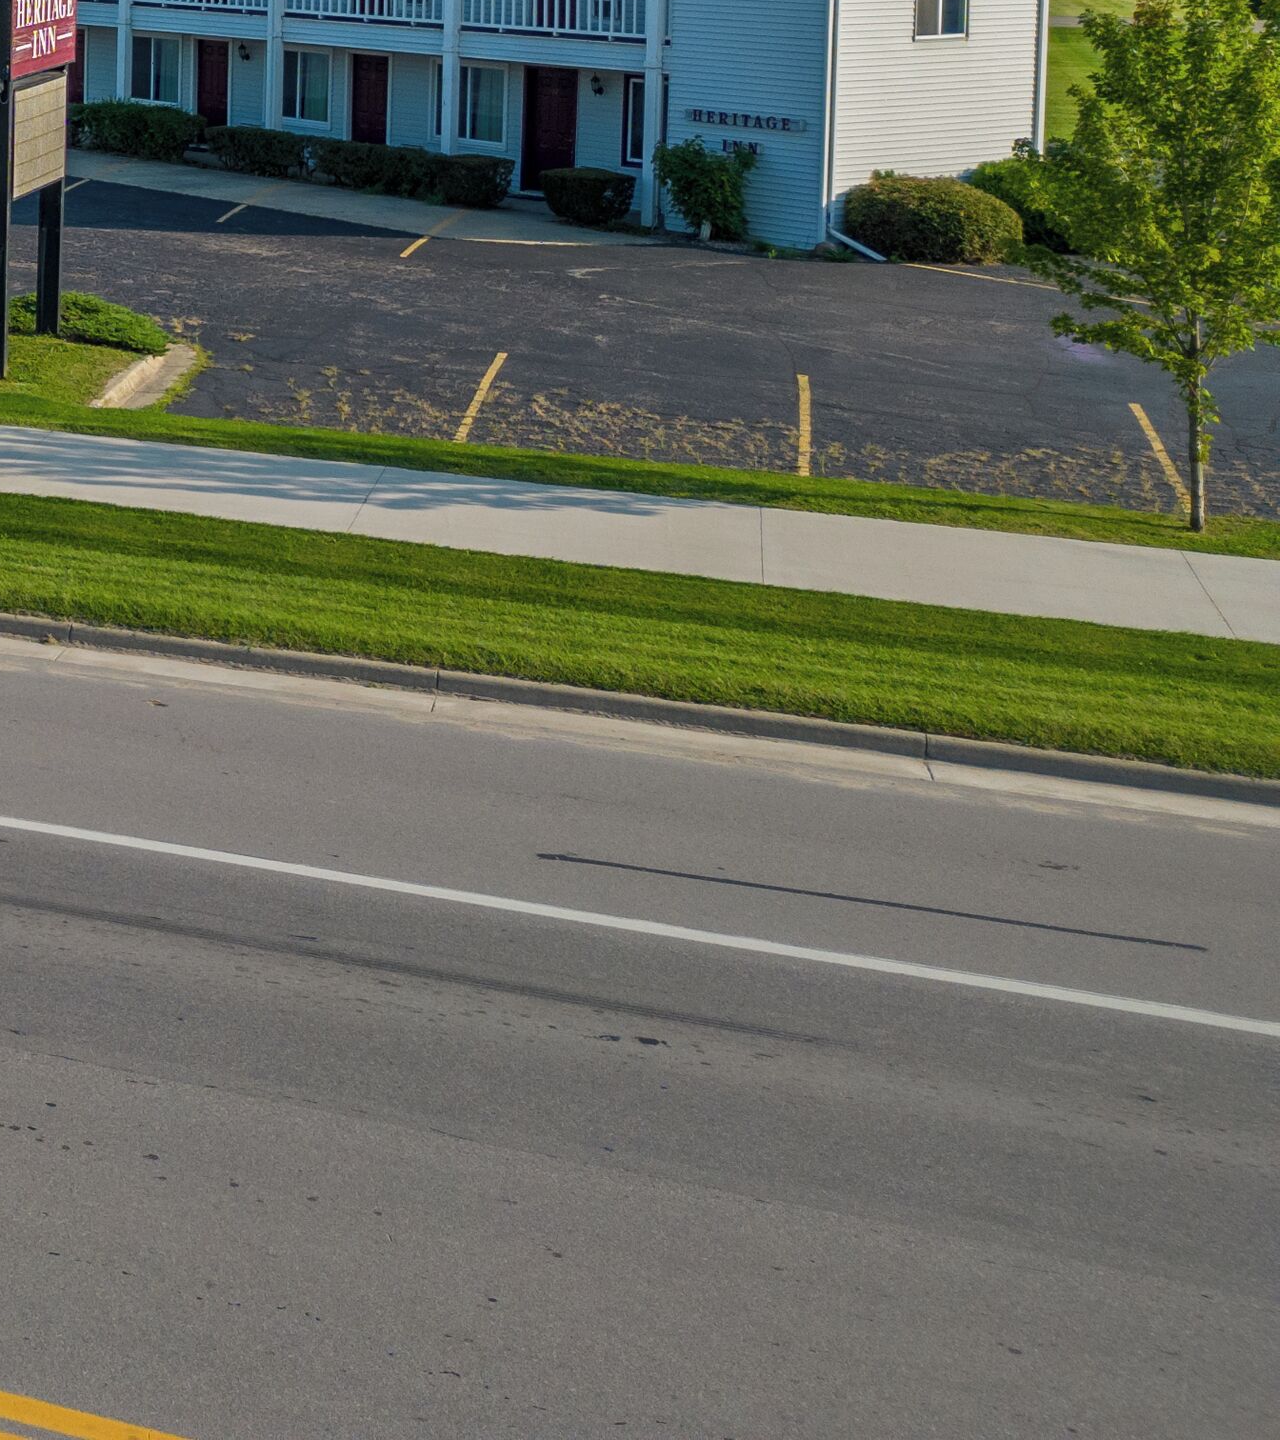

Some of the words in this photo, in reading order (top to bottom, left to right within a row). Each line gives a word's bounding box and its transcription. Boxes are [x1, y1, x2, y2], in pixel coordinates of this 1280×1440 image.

[32, 25, 57, 58] INN
[692, 109, 791, 131] HERITAGE
[722, 139, 758, 155] INN
